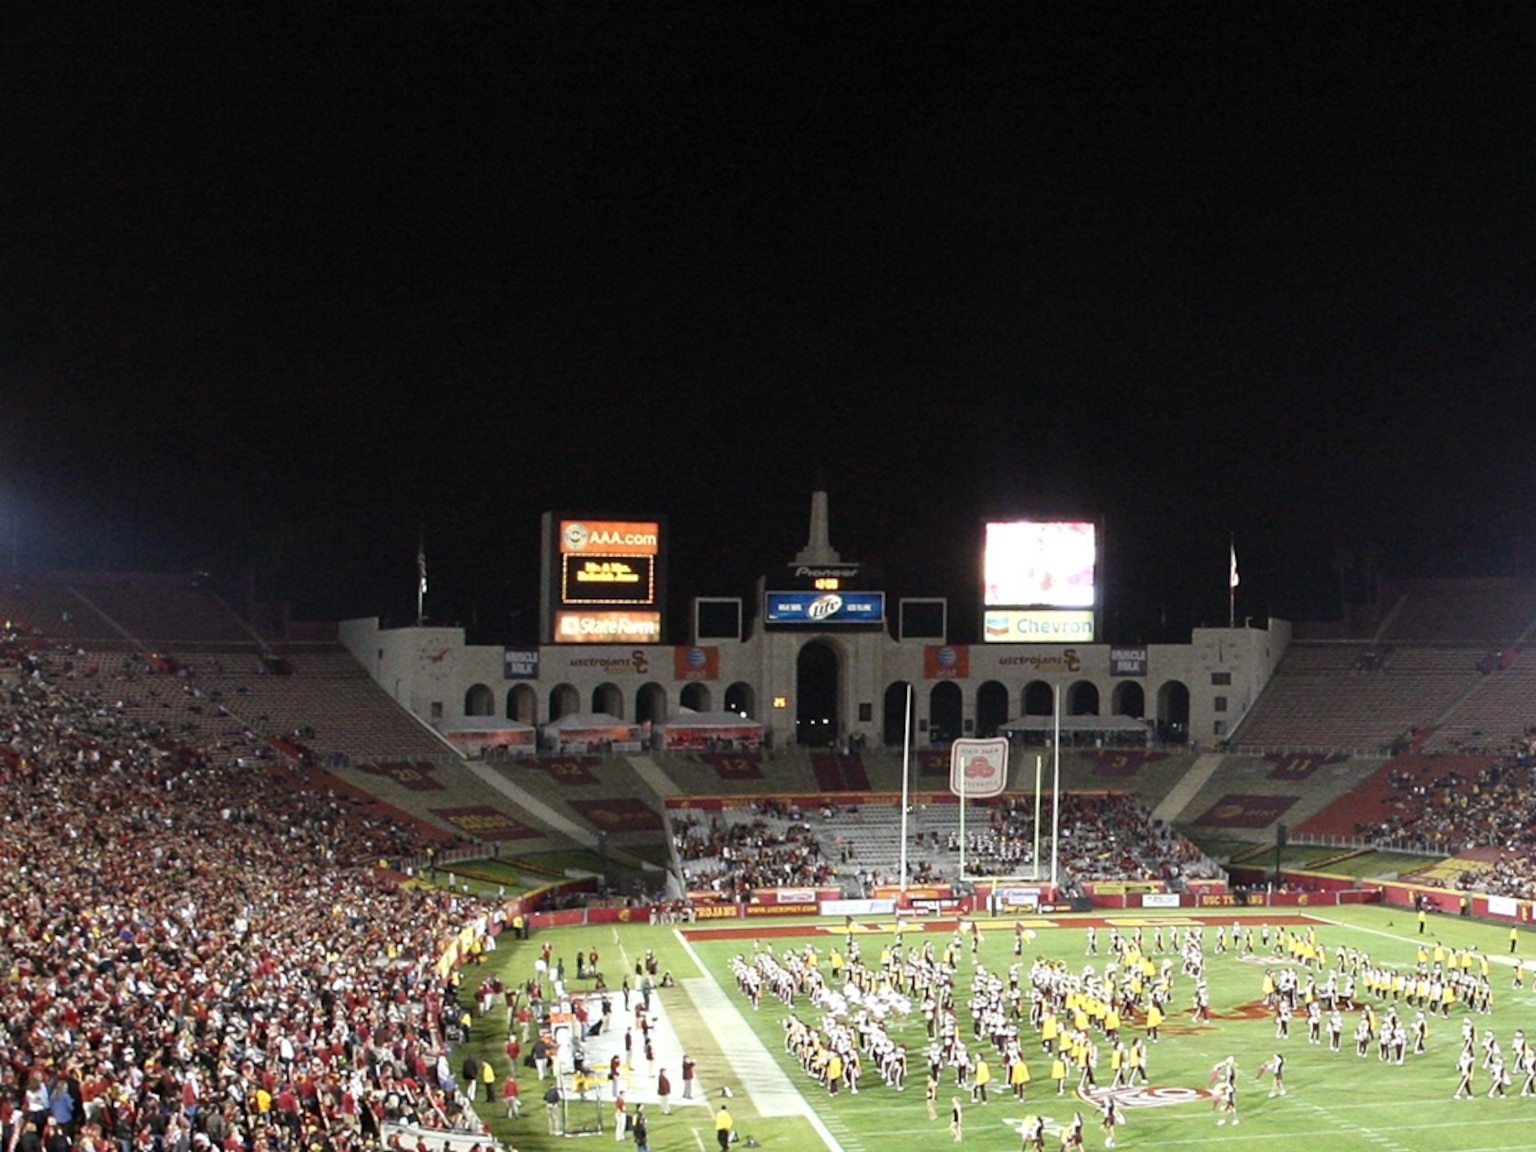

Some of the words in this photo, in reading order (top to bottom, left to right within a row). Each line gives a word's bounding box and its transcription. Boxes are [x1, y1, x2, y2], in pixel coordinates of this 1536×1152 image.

[589, 530, 657, 546] AAA.com
[795, 566, 858, 578] Pioneer
[580, 617, 616, 634] State
[616, 617, 655, 635] Farm
[1016, 618, 1093, 634] Chevron
